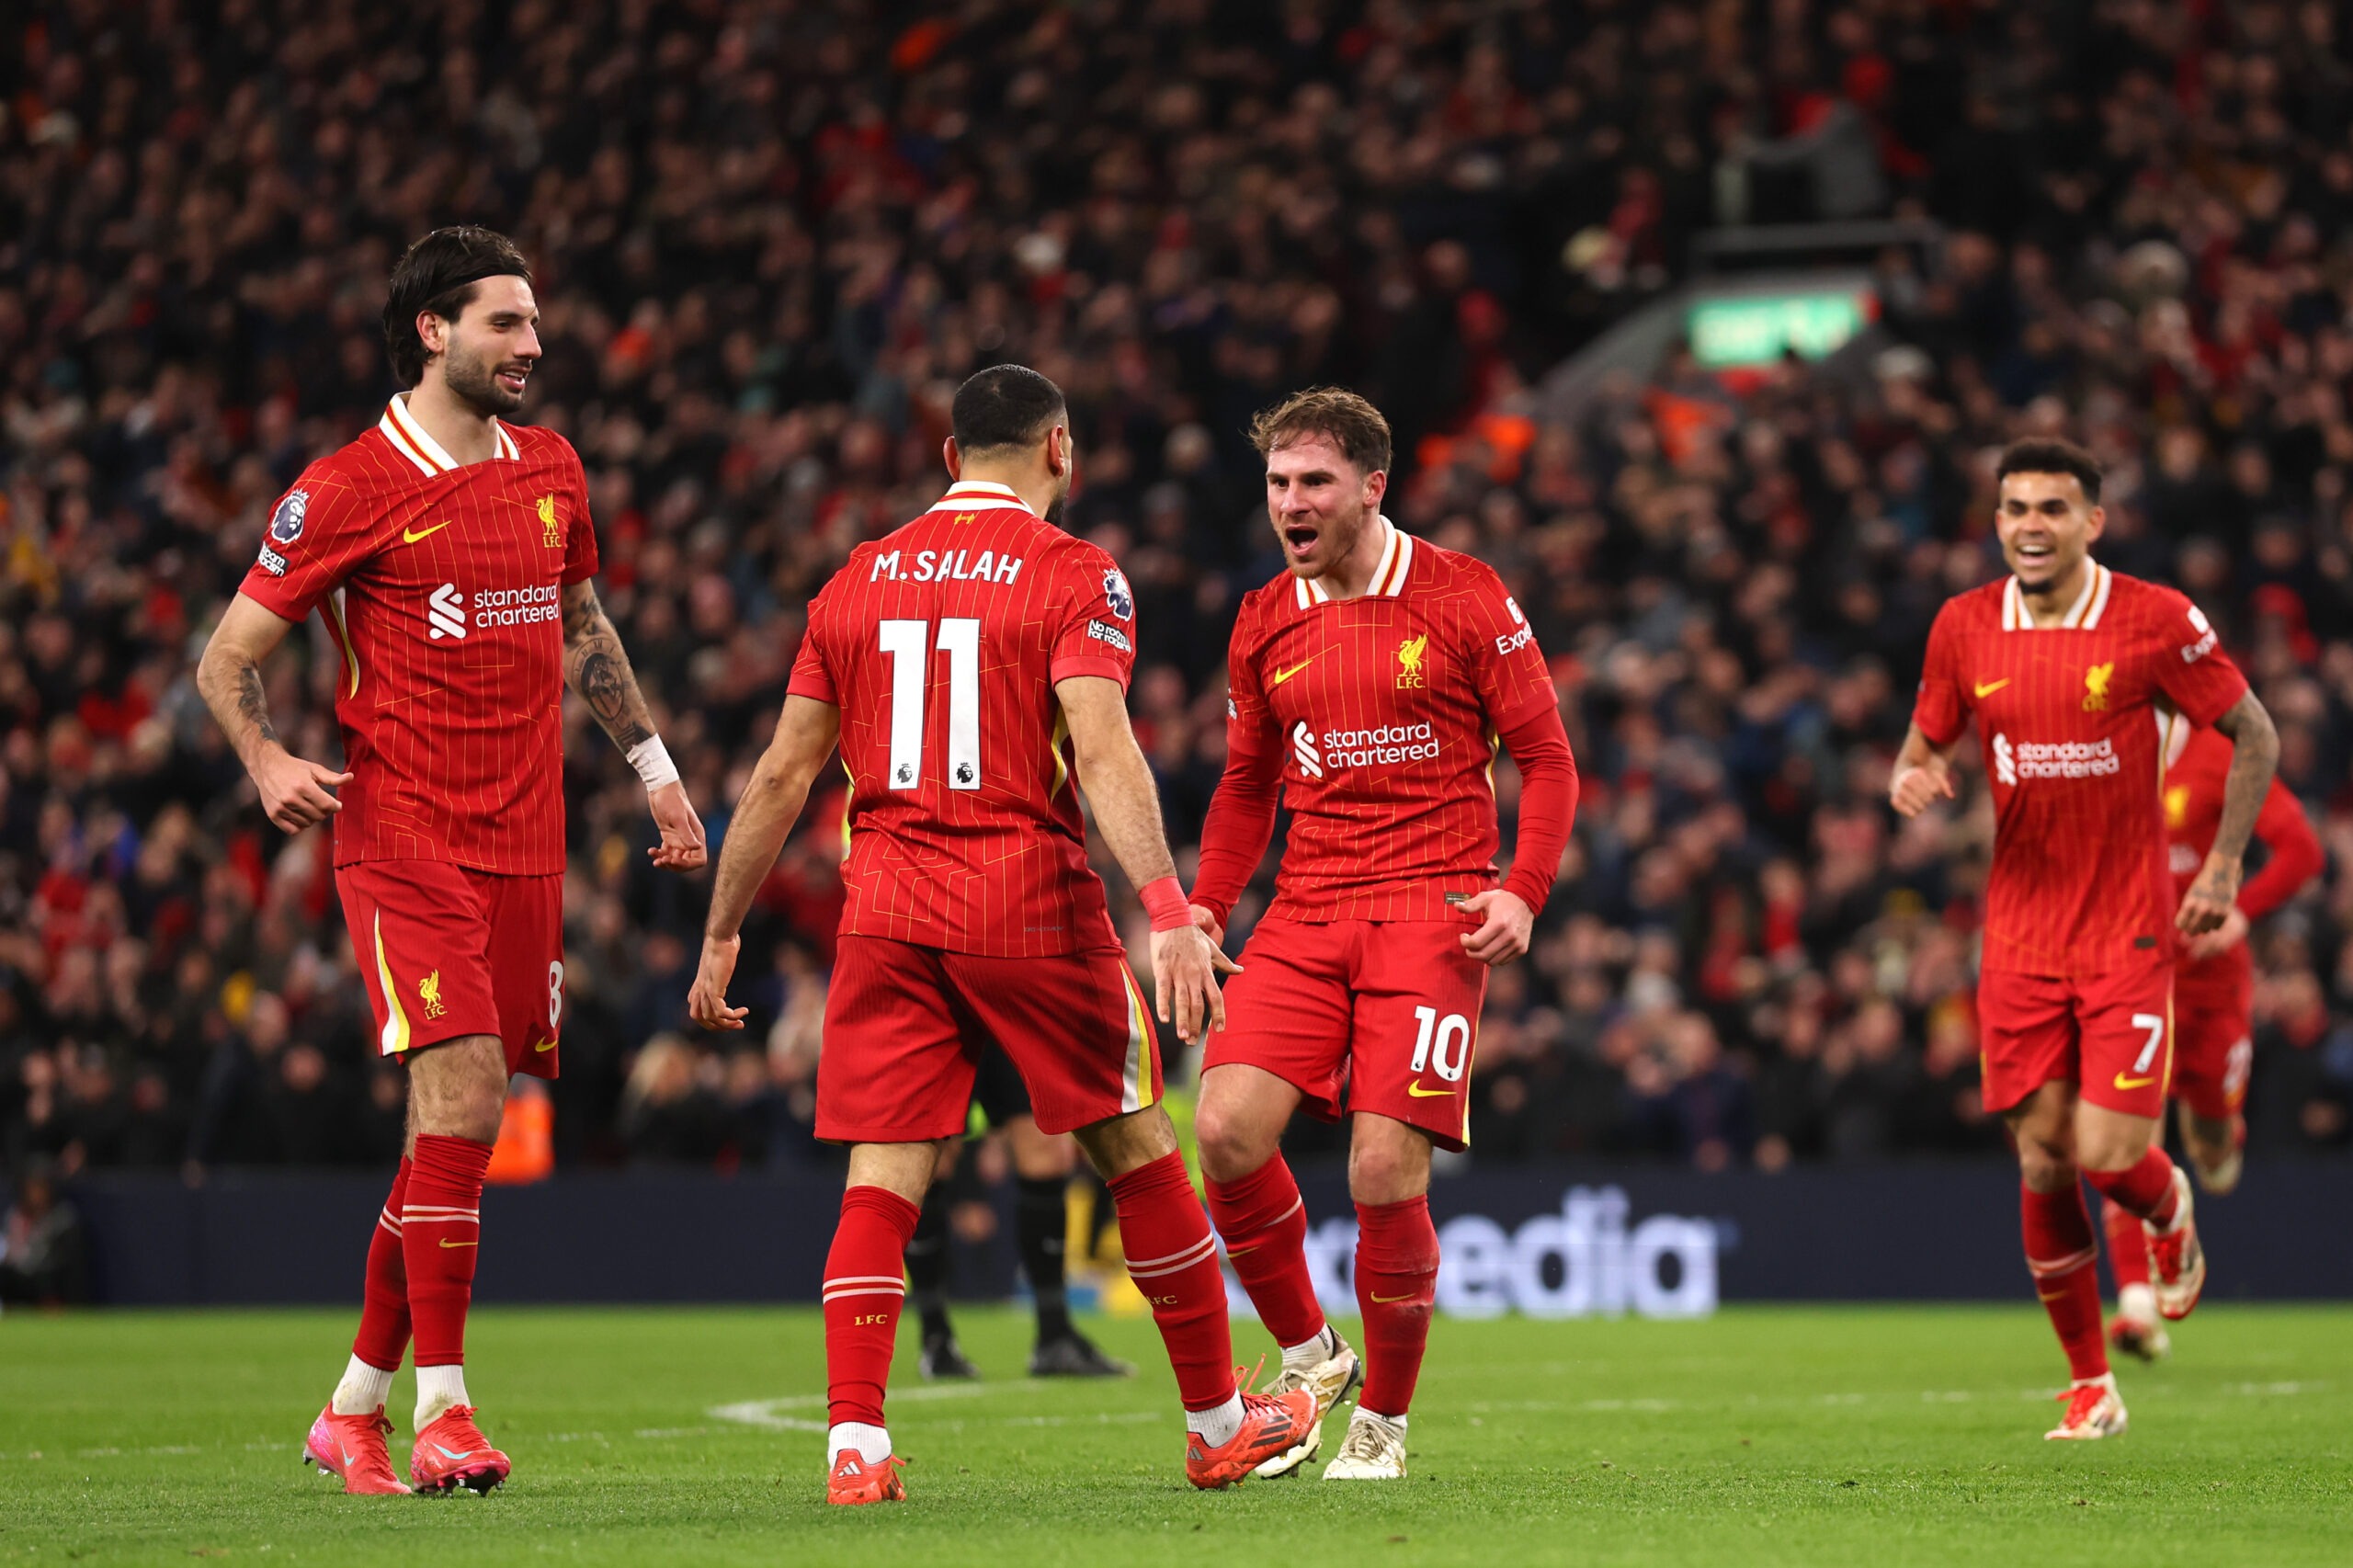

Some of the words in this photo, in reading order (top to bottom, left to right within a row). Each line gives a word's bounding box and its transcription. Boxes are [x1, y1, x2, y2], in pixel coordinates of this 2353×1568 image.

[473, 580, 559, 608] standard
[475, 599, 560, 628] chartered
[1088, 619, 1104, 632] No
[1105, 626, 1127, 644] room
[879, 617, 981, 790] 11
[1324, 721, 1431, 749] standard
[2017, 736, 2112, 761] standard
[1326, 738, 1439, 768] chartered
[2017, 753, 2120, 778] chartered
[549, 960, 564, 1028] 8
[1410, 1005, 1471, 1082] 10
[2131, 1013, 2164, 1074] 7
[854, 1313, 888, 1326] LFC
